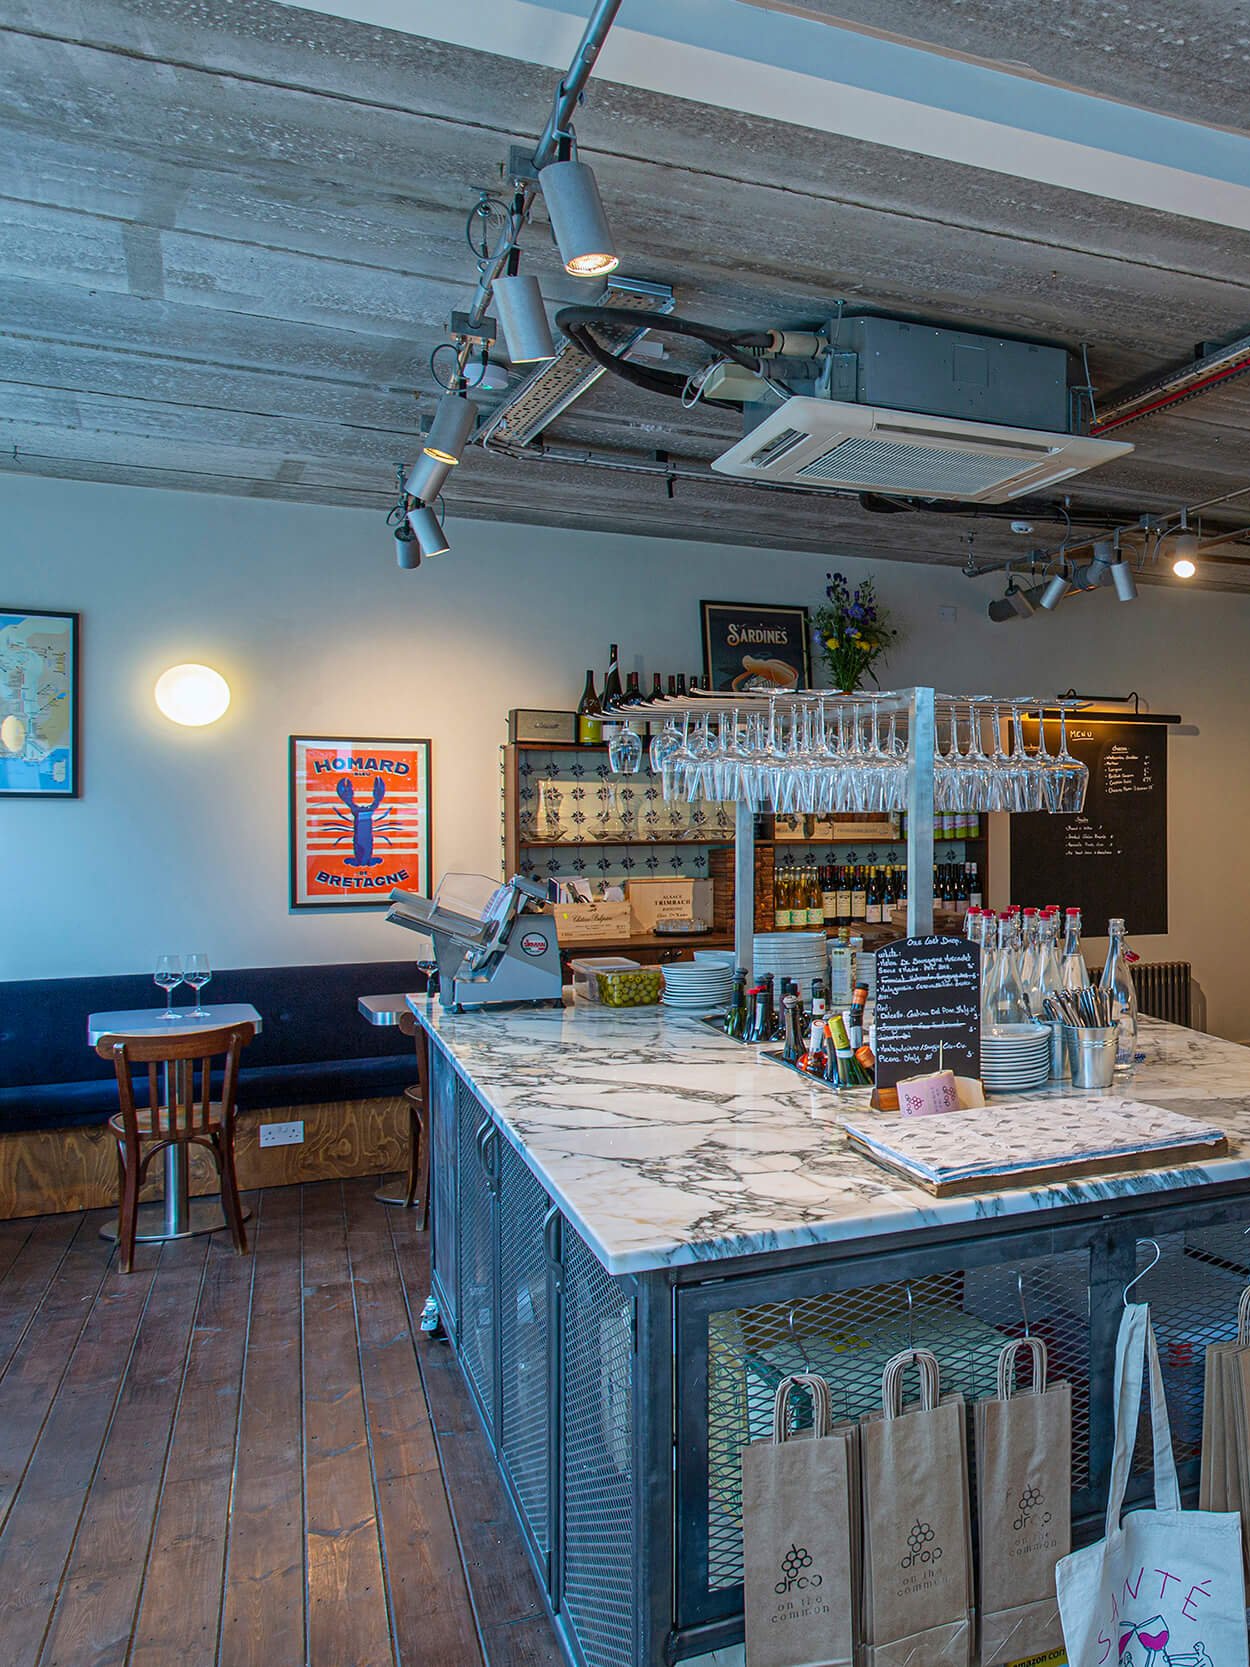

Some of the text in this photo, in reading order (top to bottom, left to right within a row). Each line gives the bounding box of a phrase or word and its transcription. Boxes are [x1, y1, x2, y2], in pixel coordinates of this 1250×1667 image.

[727, 623, 788, 646] SARDINES
[313, 757, 410, 775] HOMARD
[316, 869, 410, 888] BRETAGNE
[901, 1547, 943, 1569] drop
[778, 1602, 793, 1612] on
